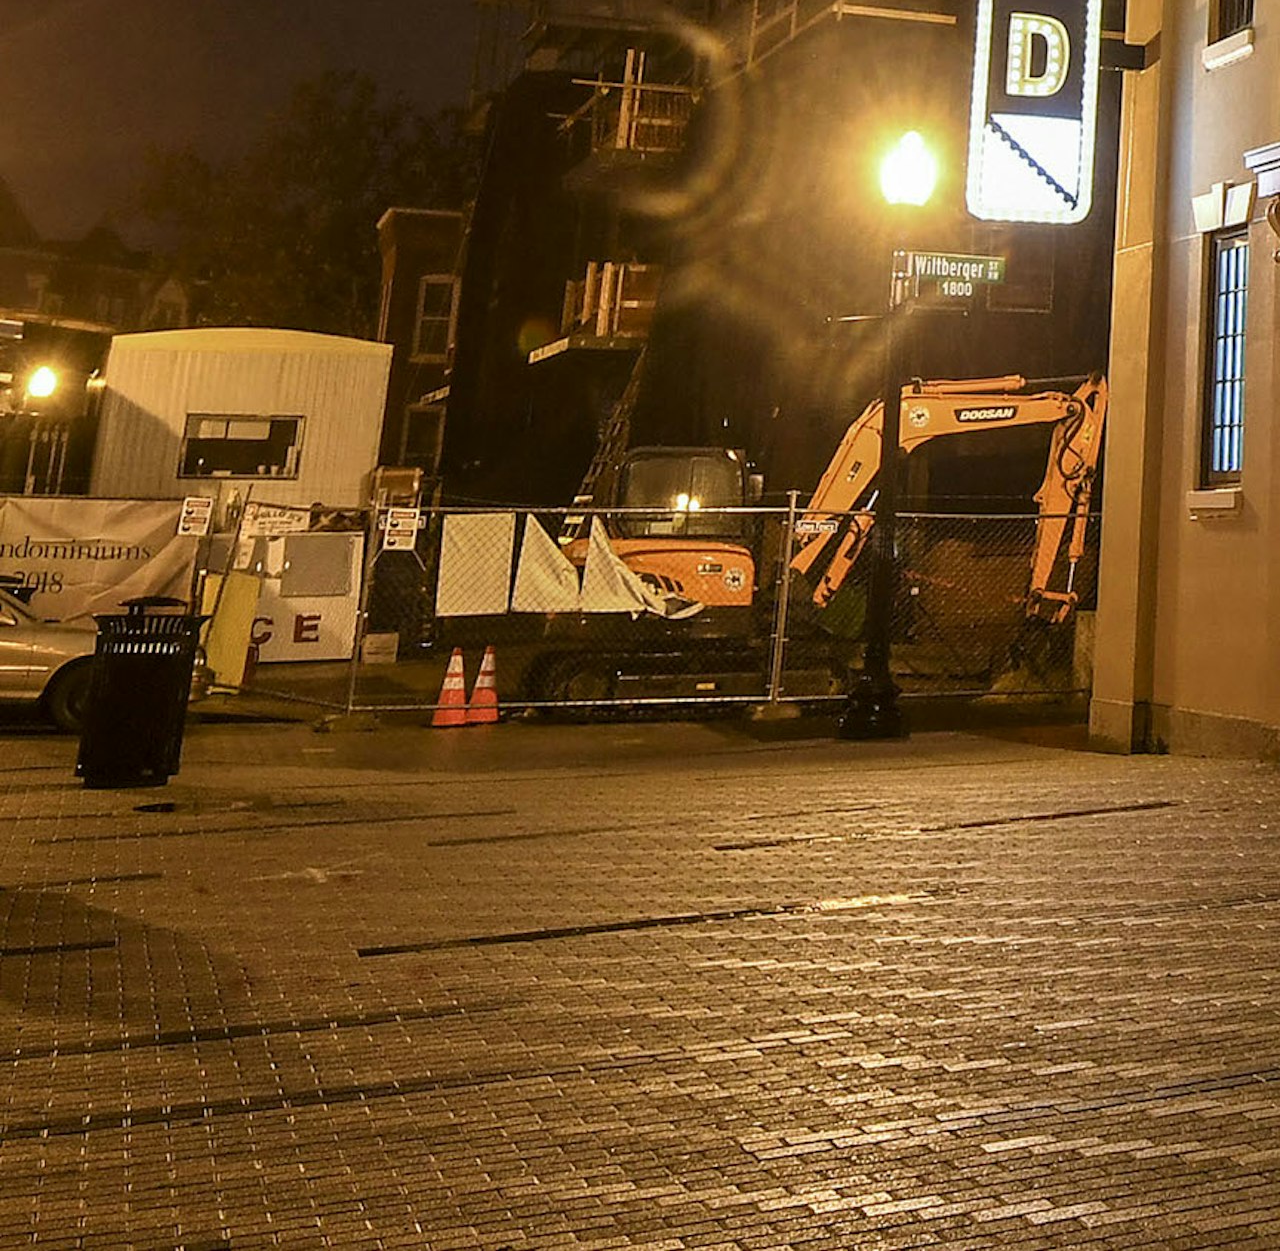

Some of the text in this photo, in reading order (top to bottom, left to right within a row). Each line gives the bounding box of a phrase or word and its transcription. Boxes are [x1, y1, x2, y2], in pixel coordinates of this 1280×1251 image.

[914, 254, 985, 282] Wiltberger
[942, 281, 974, 297] 1800
[959, 407, 1015, 422] DOOSAN
[0, 535, 152, 561] ndominiums
[14, 570, 65, 595] 2018
